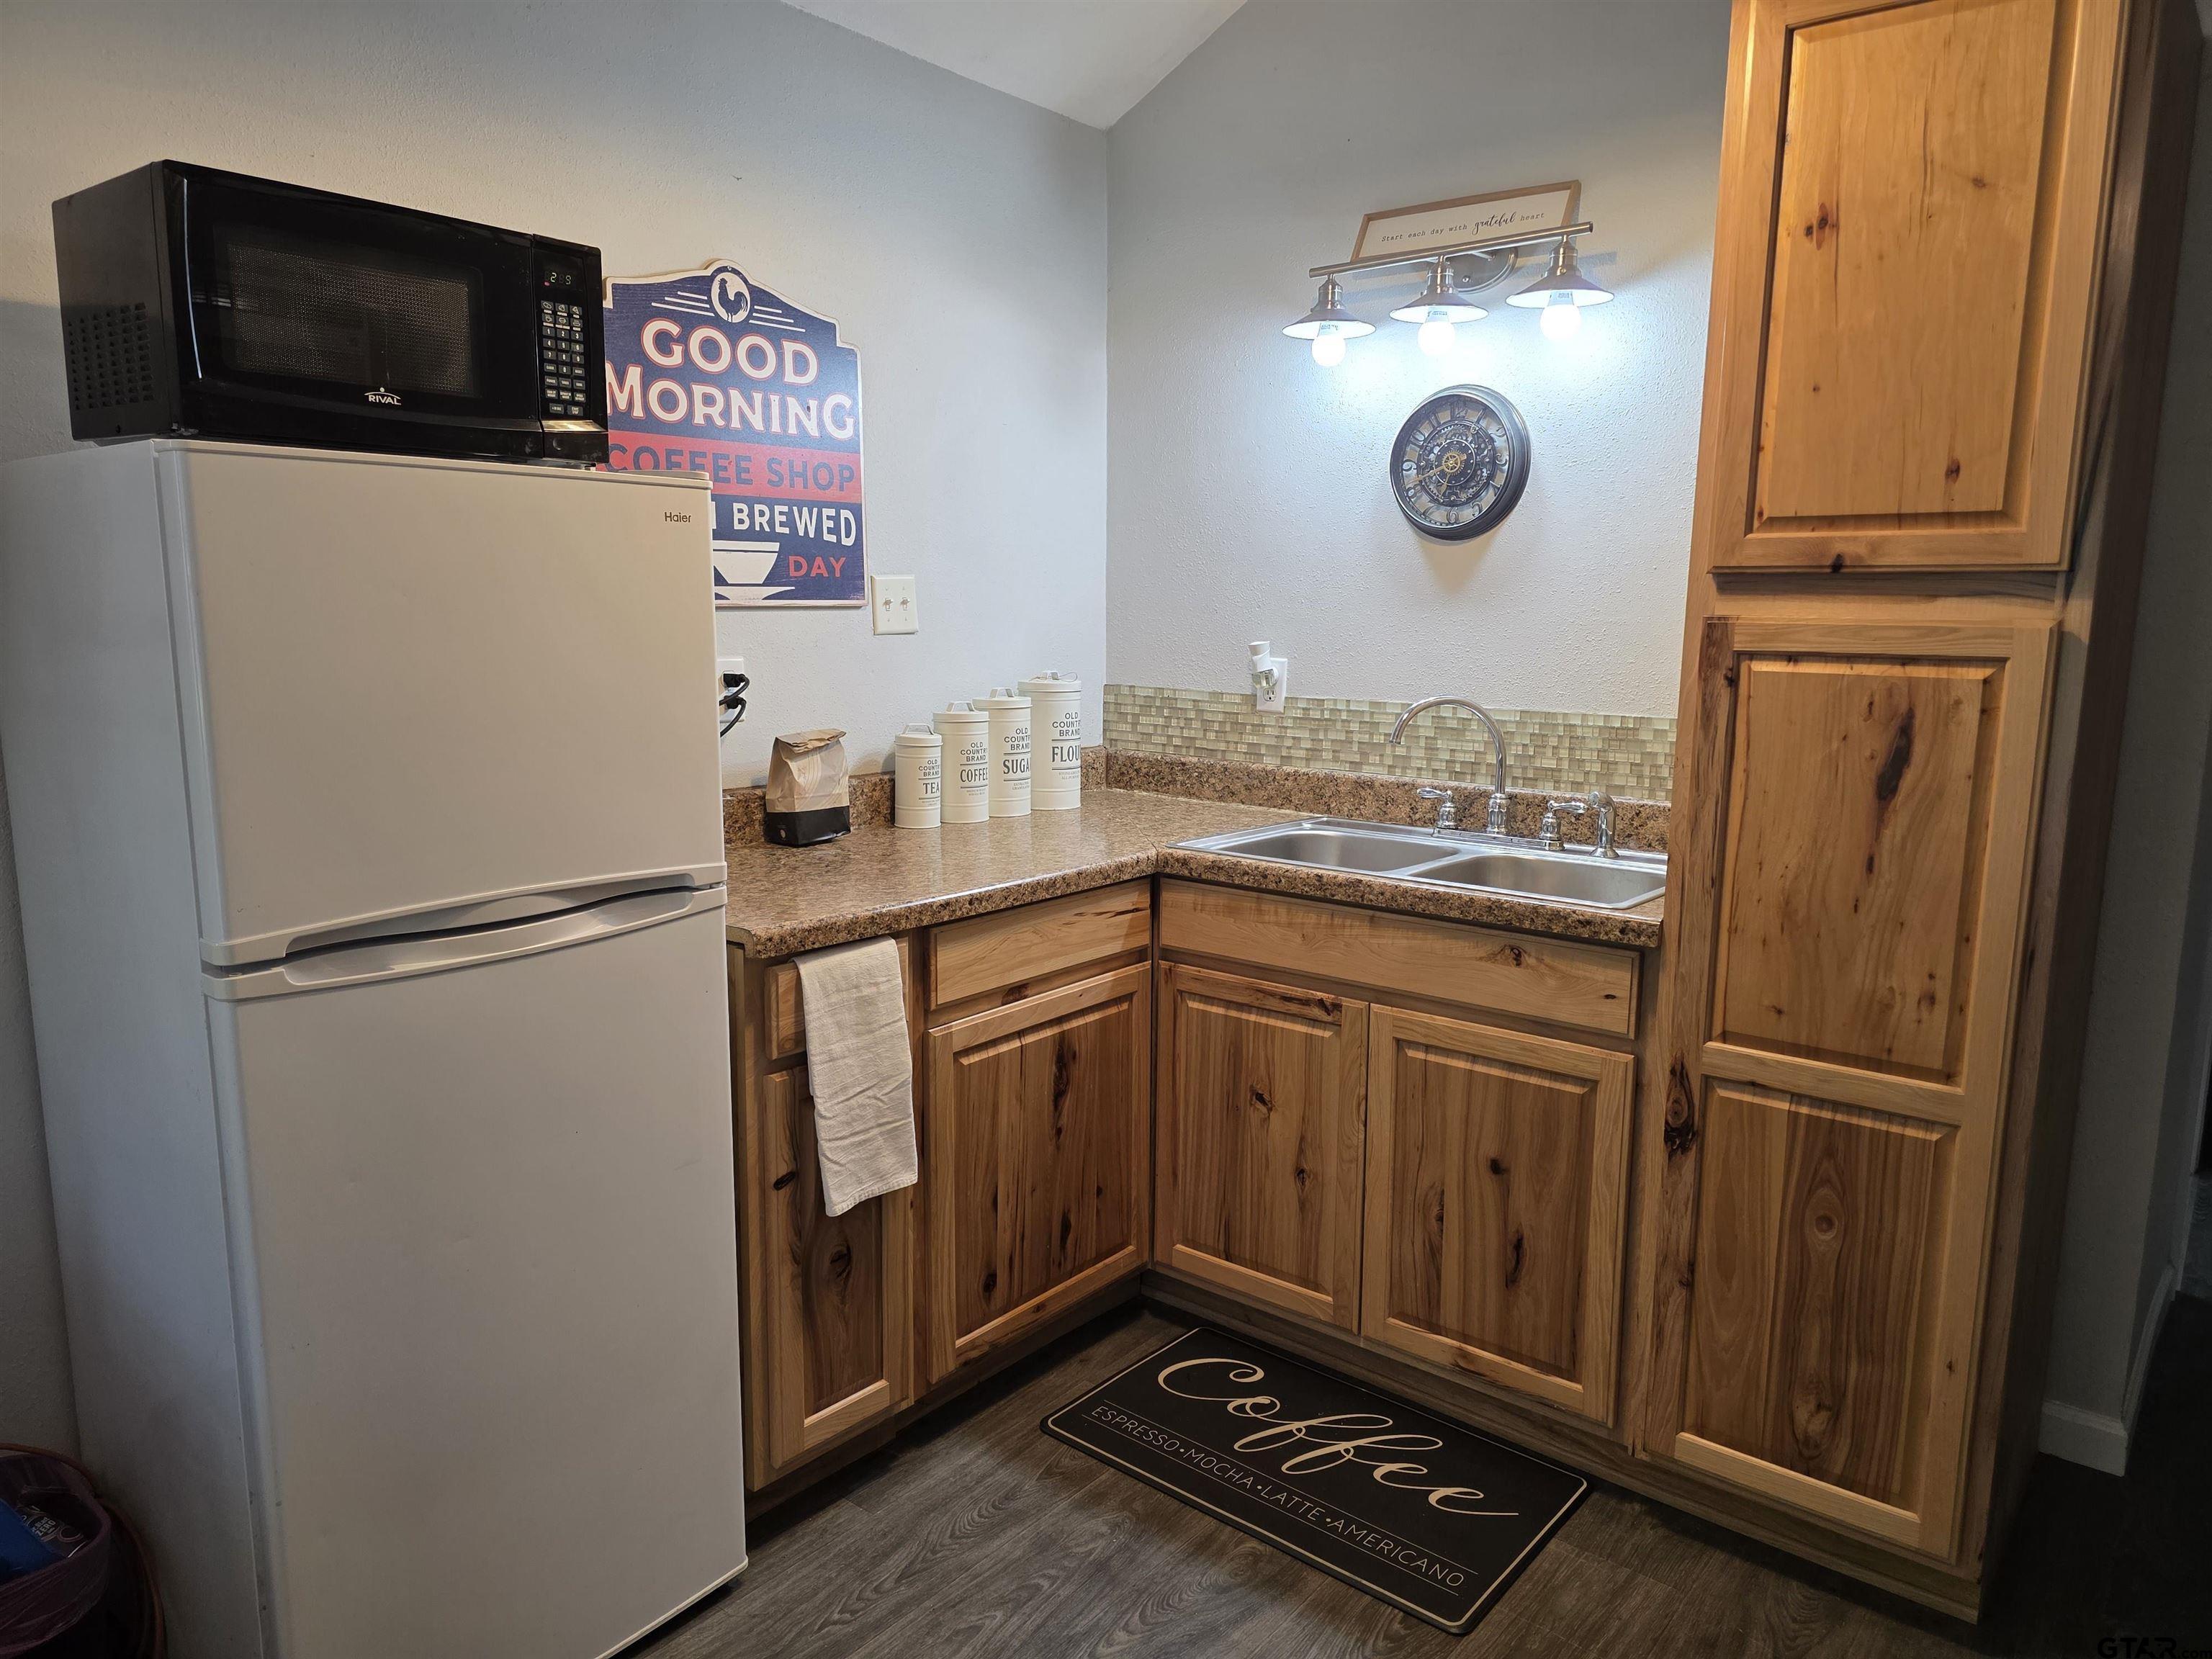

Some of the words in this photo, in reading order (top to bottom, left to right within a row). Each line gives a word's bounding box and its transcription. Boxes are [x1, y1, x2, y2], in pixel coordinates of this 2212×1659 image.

[1430, 228, 1444, 236] day
[1471, 211, 1516, 236] grateful
[1520, 212, 1545, 221] heart
[640, 318, 819, 386] GOOD
[368, 394, 402, 405] RIVAL
[607, 361, 857, 441] MORNING
[606, 443, 753, 485] COFFEE
[767, 457, 856, 493] SHOP
[664, 511, 691, 523] Haier
[732, 501, 857, 547] BREWED
[788, 555, 847, 577] DAY
[960, 767, 988, 783] COFFEE
[1002, 758, 1030, 775] SUGA
[922, 781, 939, 795] TEA
[1157, 1358, 1519, 1516] Coffee
[1091, 1405, 1179, 1452] ESPRESSO
[1183, 1448, 1254, 1490] MOCHA
[1259, 1485, 1326, 1521] LATTE
[1327, 1518, 1465, 1587] AMERICANO
